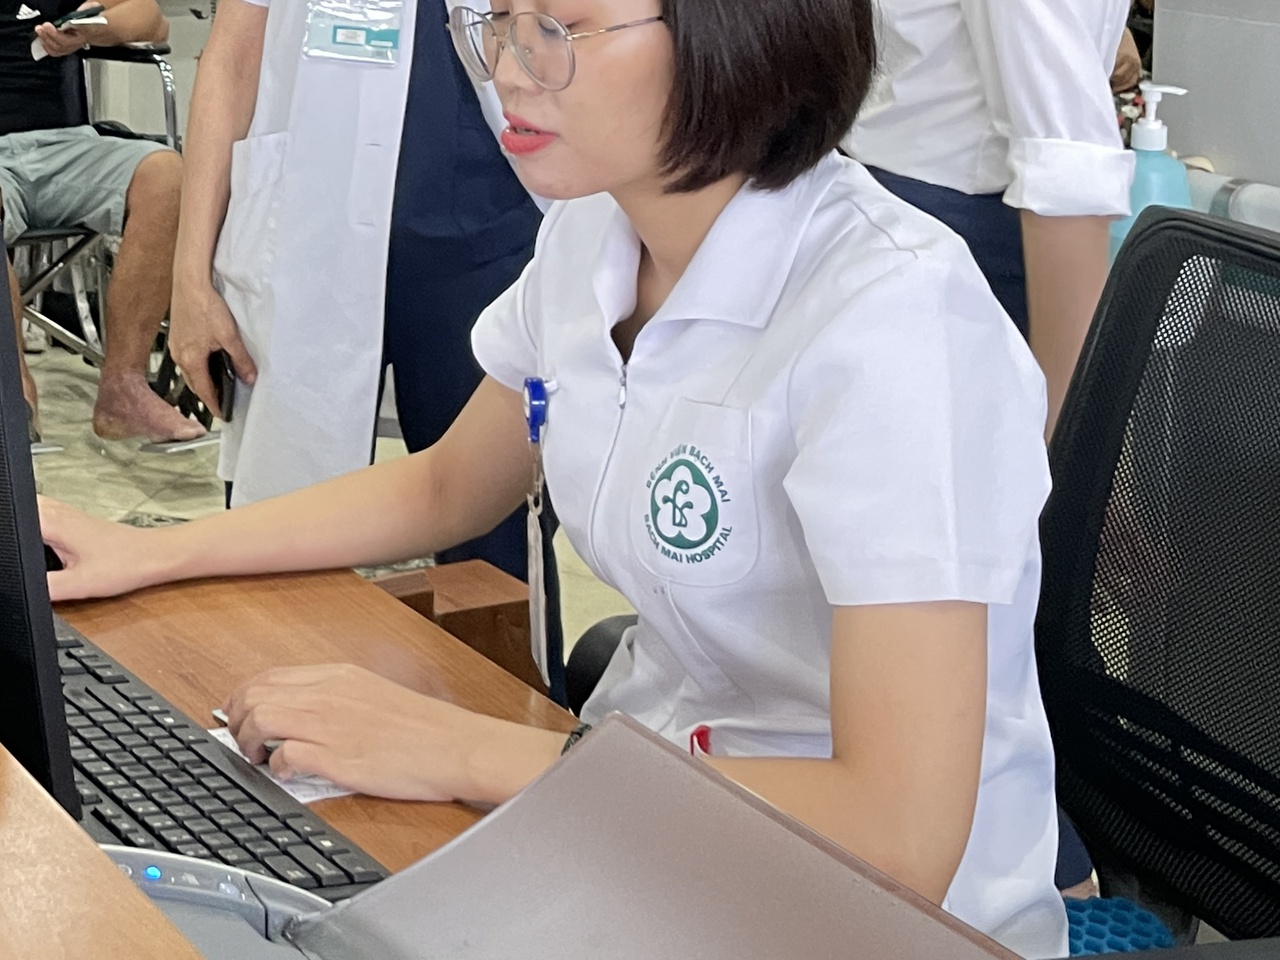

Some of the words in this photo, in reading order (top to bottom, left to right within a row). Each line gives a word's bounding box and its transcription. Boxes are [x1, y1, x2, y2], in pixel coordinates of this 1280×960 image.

[712, 474, 731, 503] MAI
[644, 514, 660, 549] BACH
[661, 545, 683, 563] MAI
[685, 526, 733, 564] HOSPITAL
